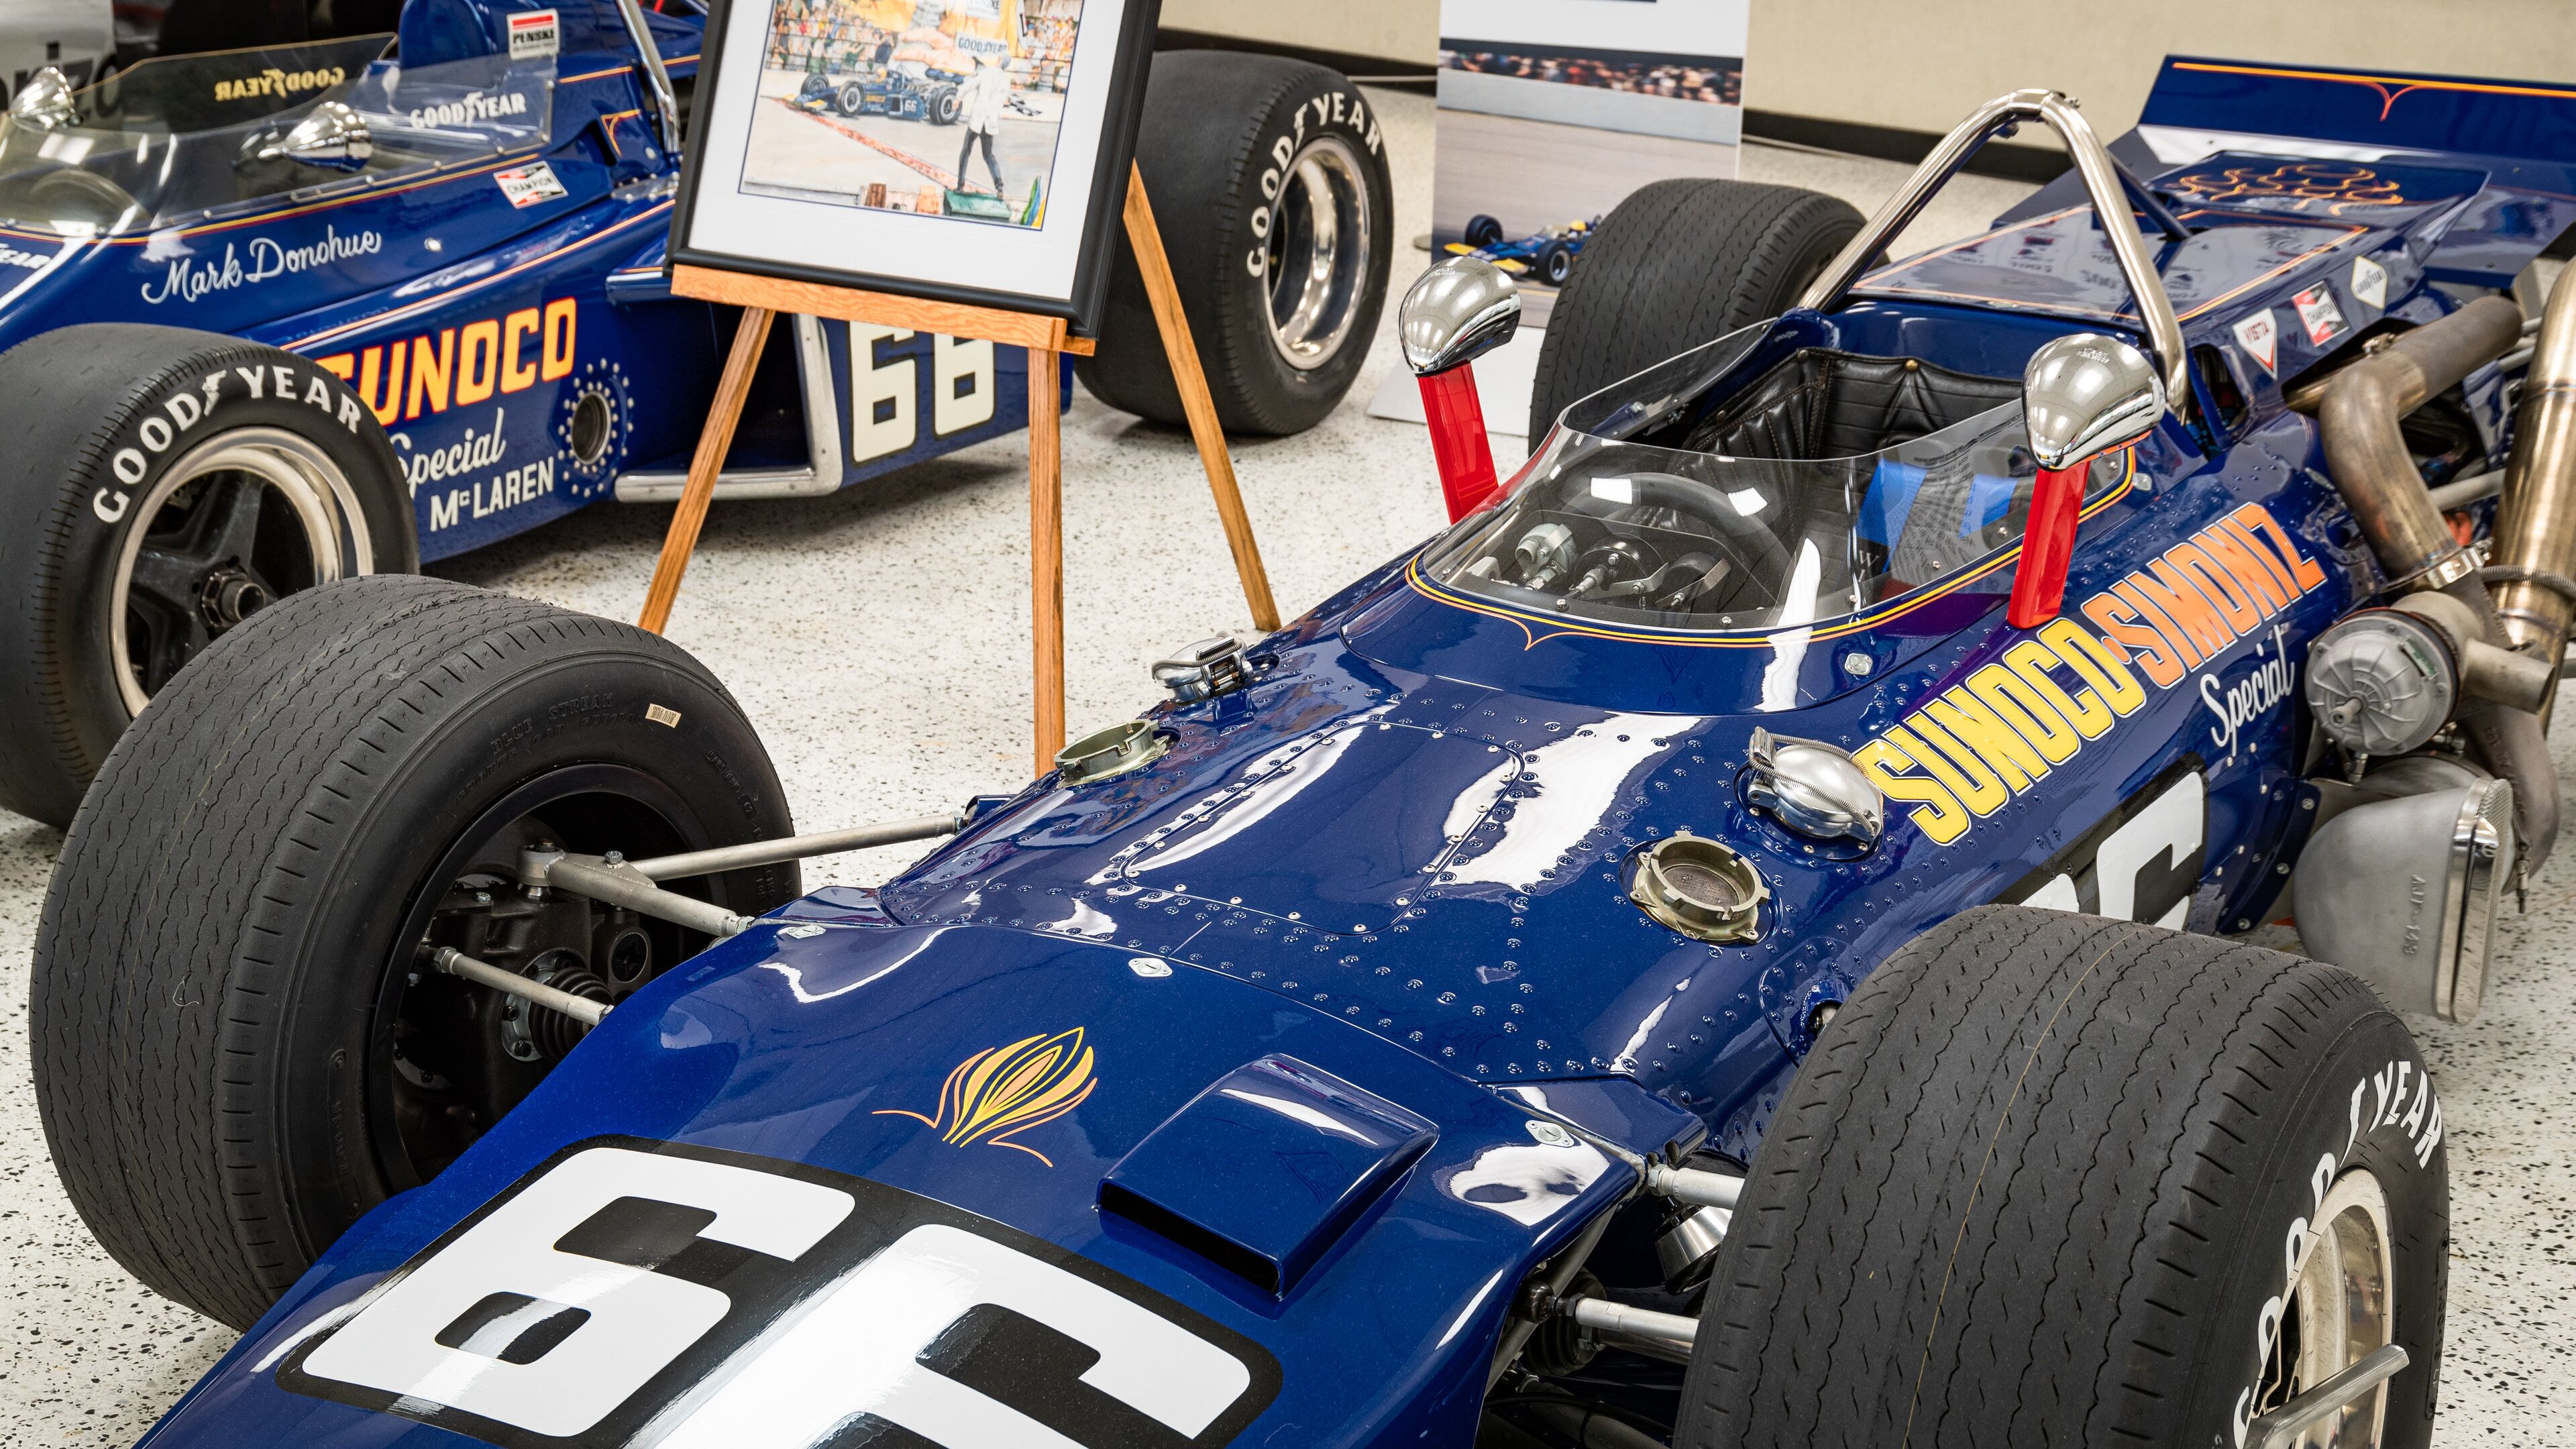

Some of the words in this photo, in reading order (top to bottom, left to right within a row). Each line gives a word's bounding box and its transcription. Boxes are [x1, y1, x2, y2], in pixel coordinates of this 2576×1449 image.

[513, 29, 554, 44] PENSKE
[409, 91, 527, 129] GOODYEAR
[904, 99, 918, 112] 66
[1246, 91, 1381, 278] GOODYEAR
[141, 241, 243, 305] Mark
[245, 223, 382, 283] Donohue
[2357, 269, 2385, 295] GOODYEAR
[2306, 301, 2338, 325] CHAMPION
[849, 321, 994, 463] 66
[93, 364, 362, 524] GOODYEAR
[390, 407, 507, 502] Special
[430, 456, 555, 532] McLAREN
[490, 718, 533, 755] BLUE
[548, 693, 614, 720] STREAK
[2200, 625, 2296, 757] Special
[301, 1146, 1251, 1449] 66
